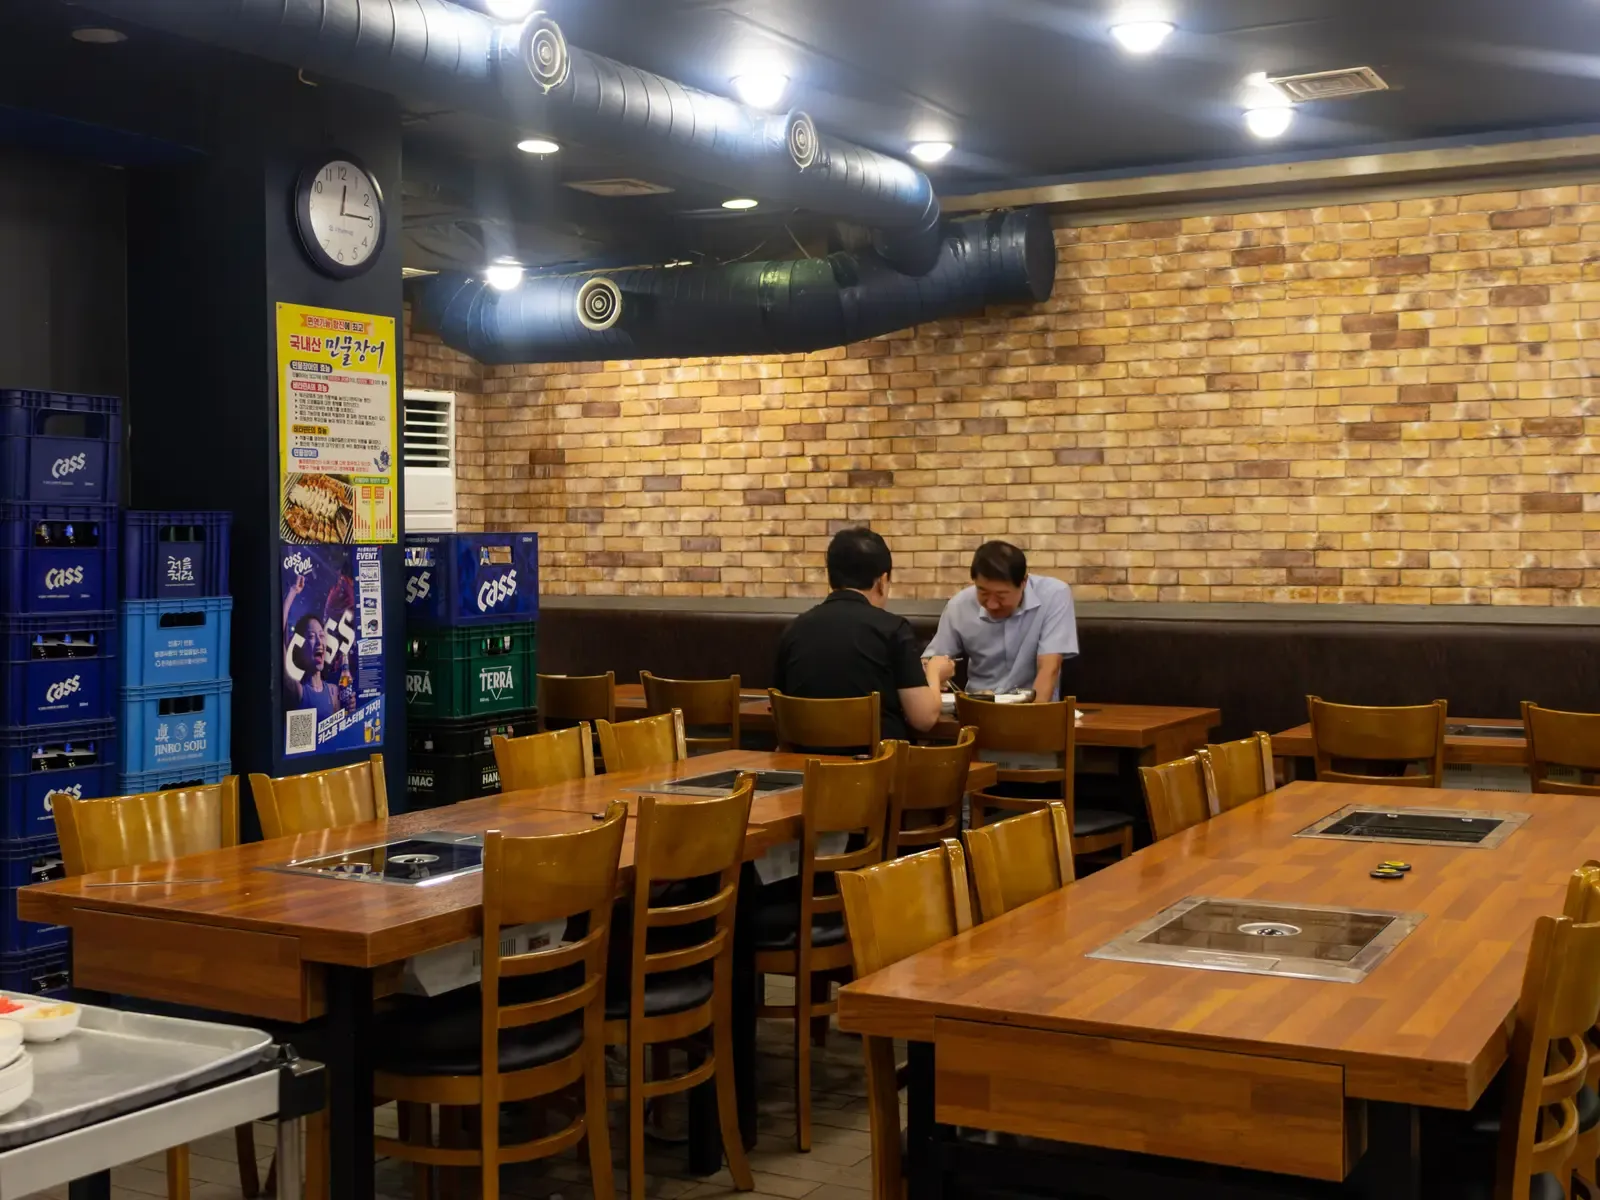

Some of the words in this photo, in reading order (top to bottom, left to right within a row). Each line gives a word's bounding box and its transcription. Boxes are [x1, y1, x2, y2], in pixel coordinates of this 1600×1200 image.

[326, 168, 332, 182] 11
[338, 166, 346, 180] 12
[315, 180, 322, 193] 10
[364, 194, 370, 207] 2
[368, 216, 374, 228] 3
[361, 236, 368, 248] 4
[337, 248, 344, 261] 6
[352, 247, 358, 260] 5
[352, 322, 364, 332] 최고
[290, 335, 321, 352] 국내산
[325, 335, 385, 370] 민물장어
[52, 452, 86, 478] Cass
[167, 555, 192, 570] 처음
[45, 565, 83, 590] Cass
[168, 570, 194, 581] 처럼
[477, 569, 517, 612] Cass
[46, 675, 81, 703] Cass
[154, 743, 180, 756] JINRO
[184, 740, 206, 751] SOJU
